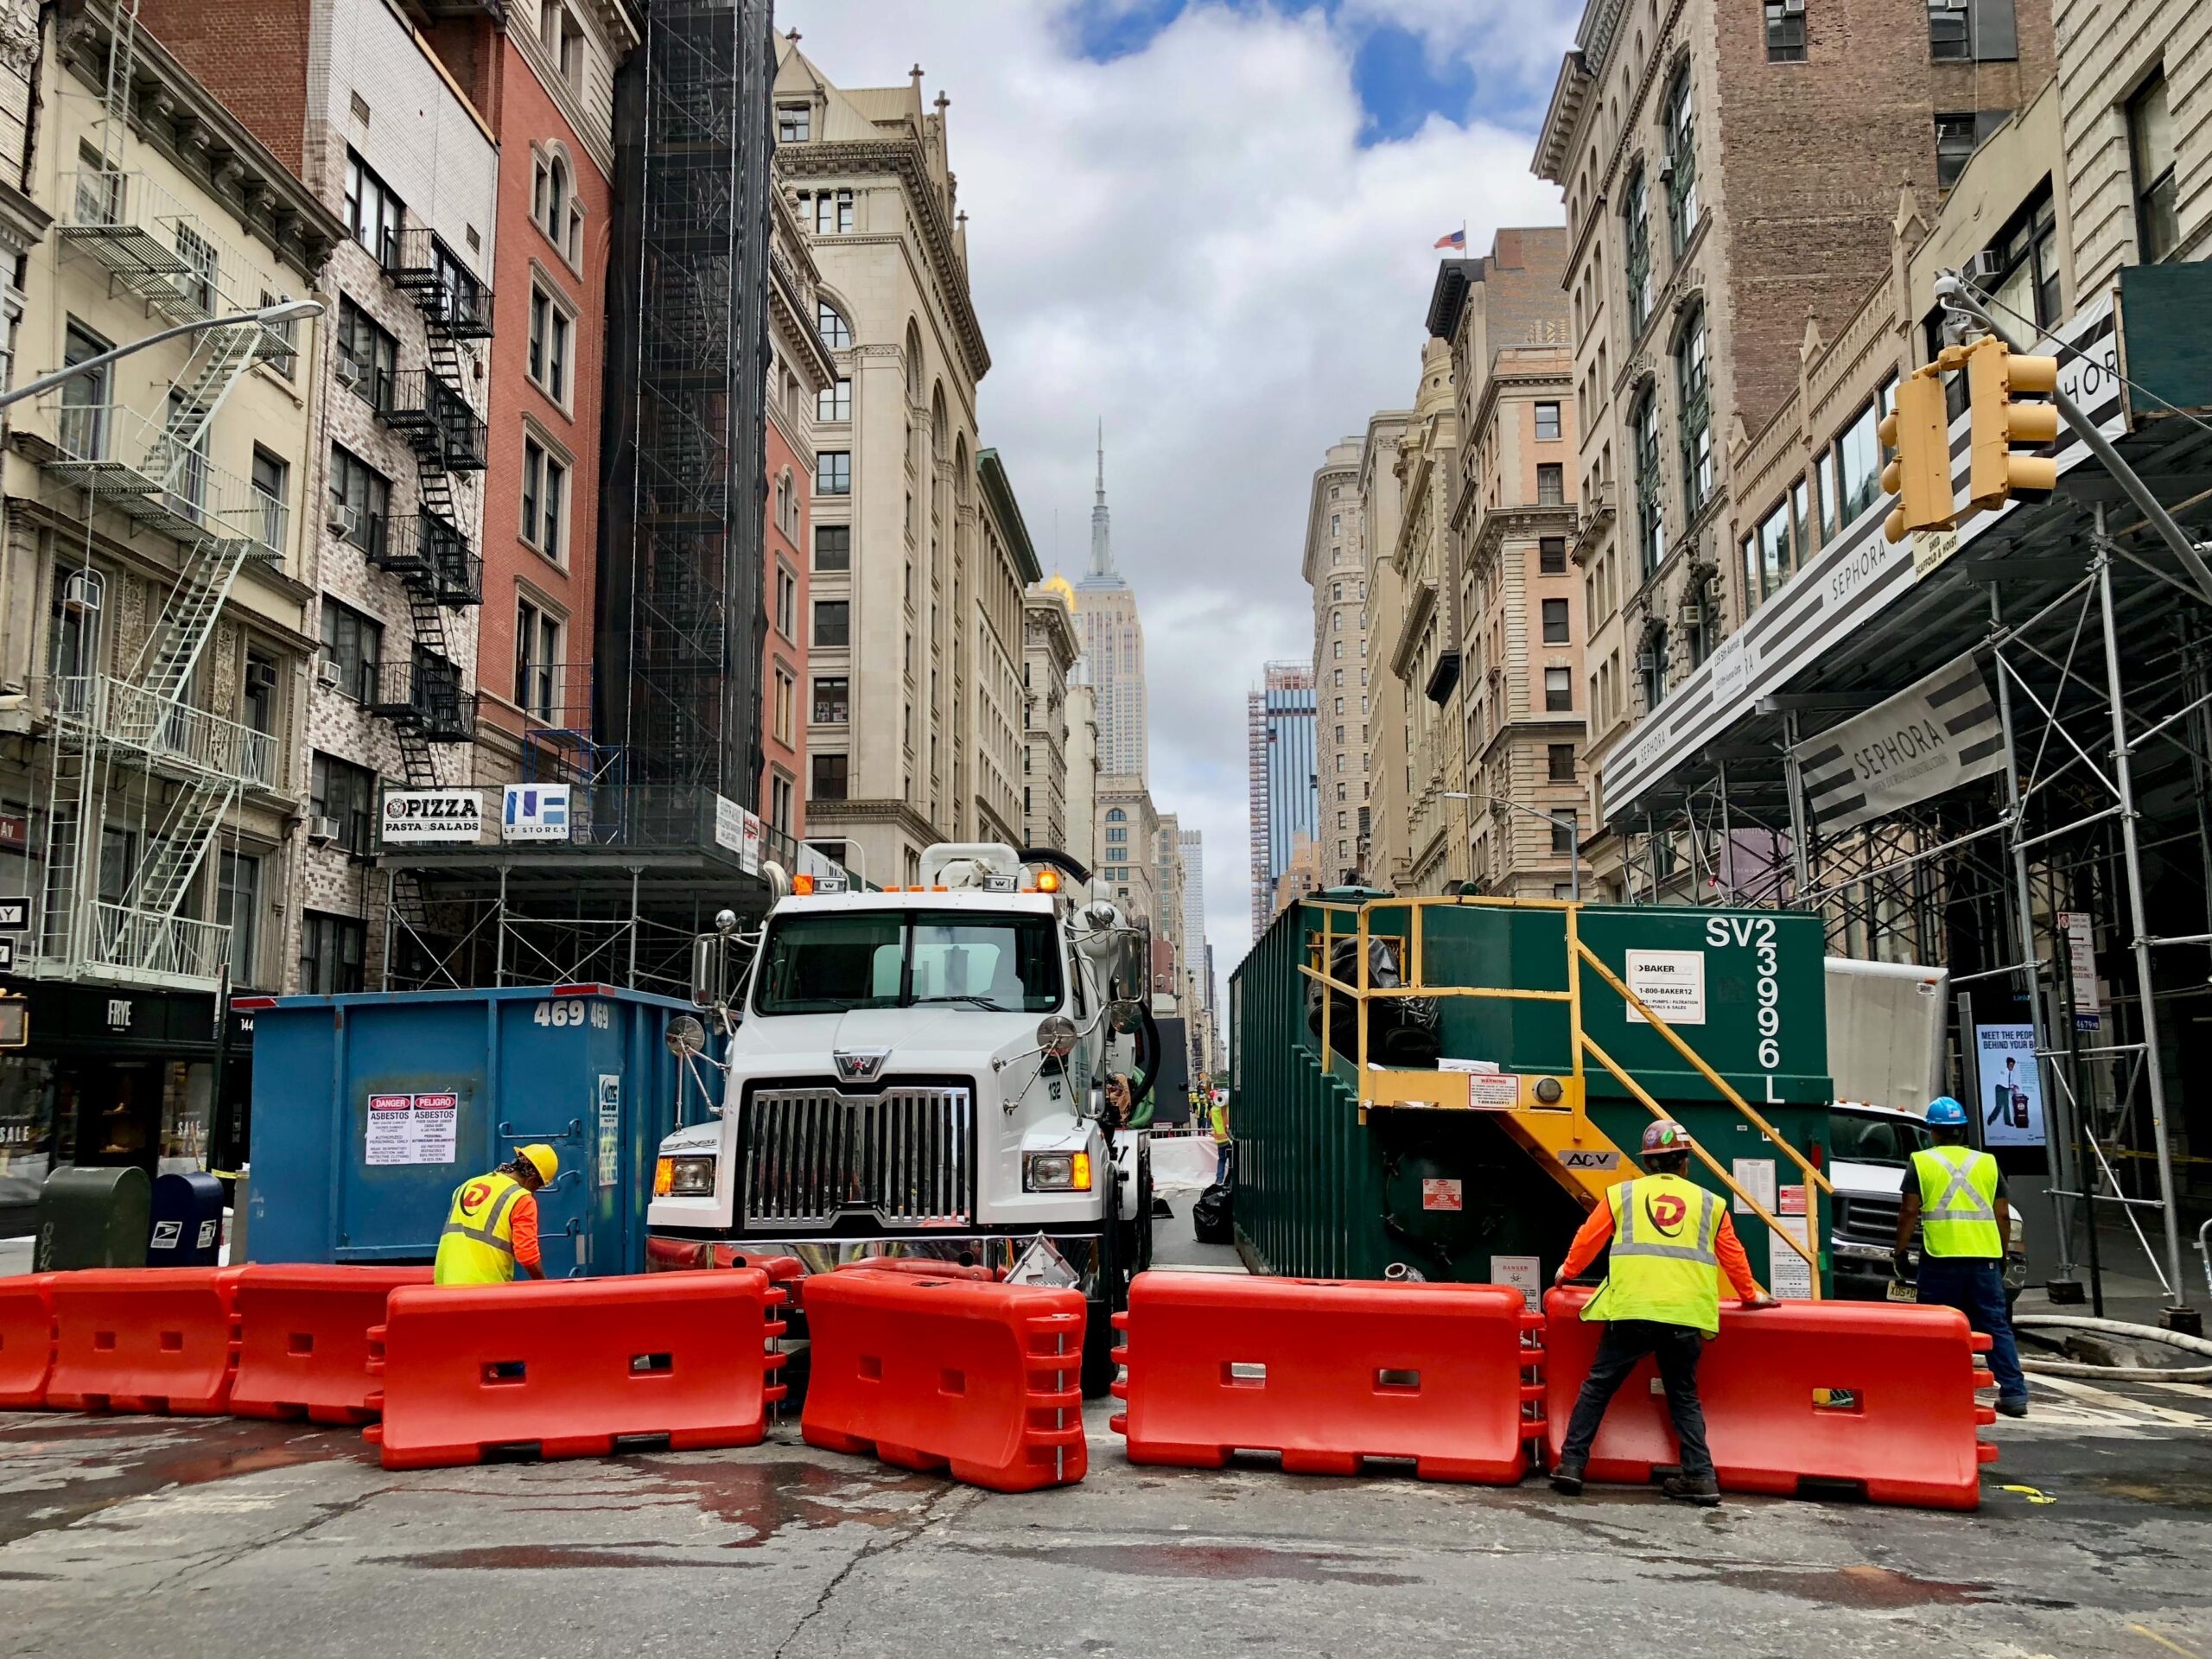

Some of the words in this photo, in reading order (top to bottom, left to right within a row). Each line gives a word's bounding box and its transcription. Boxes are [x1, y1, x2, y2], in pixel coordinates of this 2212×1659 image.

[1942, 535, 1957, 554] HOIST
[1832, 538, 1886, 601] SEPHORA
[1641, 730, 1666, 764] SEPHORA
[1853, 718, 1945, 779] SEPHORA
[405, 798, 479, 819] PIZZA
[385, 823, 423, 831] PASTA
[429, 822, 479, 831] SALADS
[107, 999, 132, 1027] FRYE
[533, 1000, 585, 1027] 469
[590, 1001, 609, 1030] 469
[1981, 1031, 2000, 1039] MEET
[2001, 1031, 2014, 1039] THE
[2016, 1031, 2033, 1039] PEOP
[1983, 1040, 2008, 1050] BEHIND
[2010, 1040, 2027, 1049] YOUR
[1048, 1081, 1061, 1101] 132
[375, 1099, 406, 1108] DANGER
[419, 1098, 452, 1106] PELIGRO
[371, 1111, 410, 1121] ASBESTOS
[415, 1110, 454, 1119] ASBESTOS
[0, 1125, 29, 1143] SALE
[178, 1121, 201, 1135] SAE
[1567, 1153, 1610, 1167] ACV
